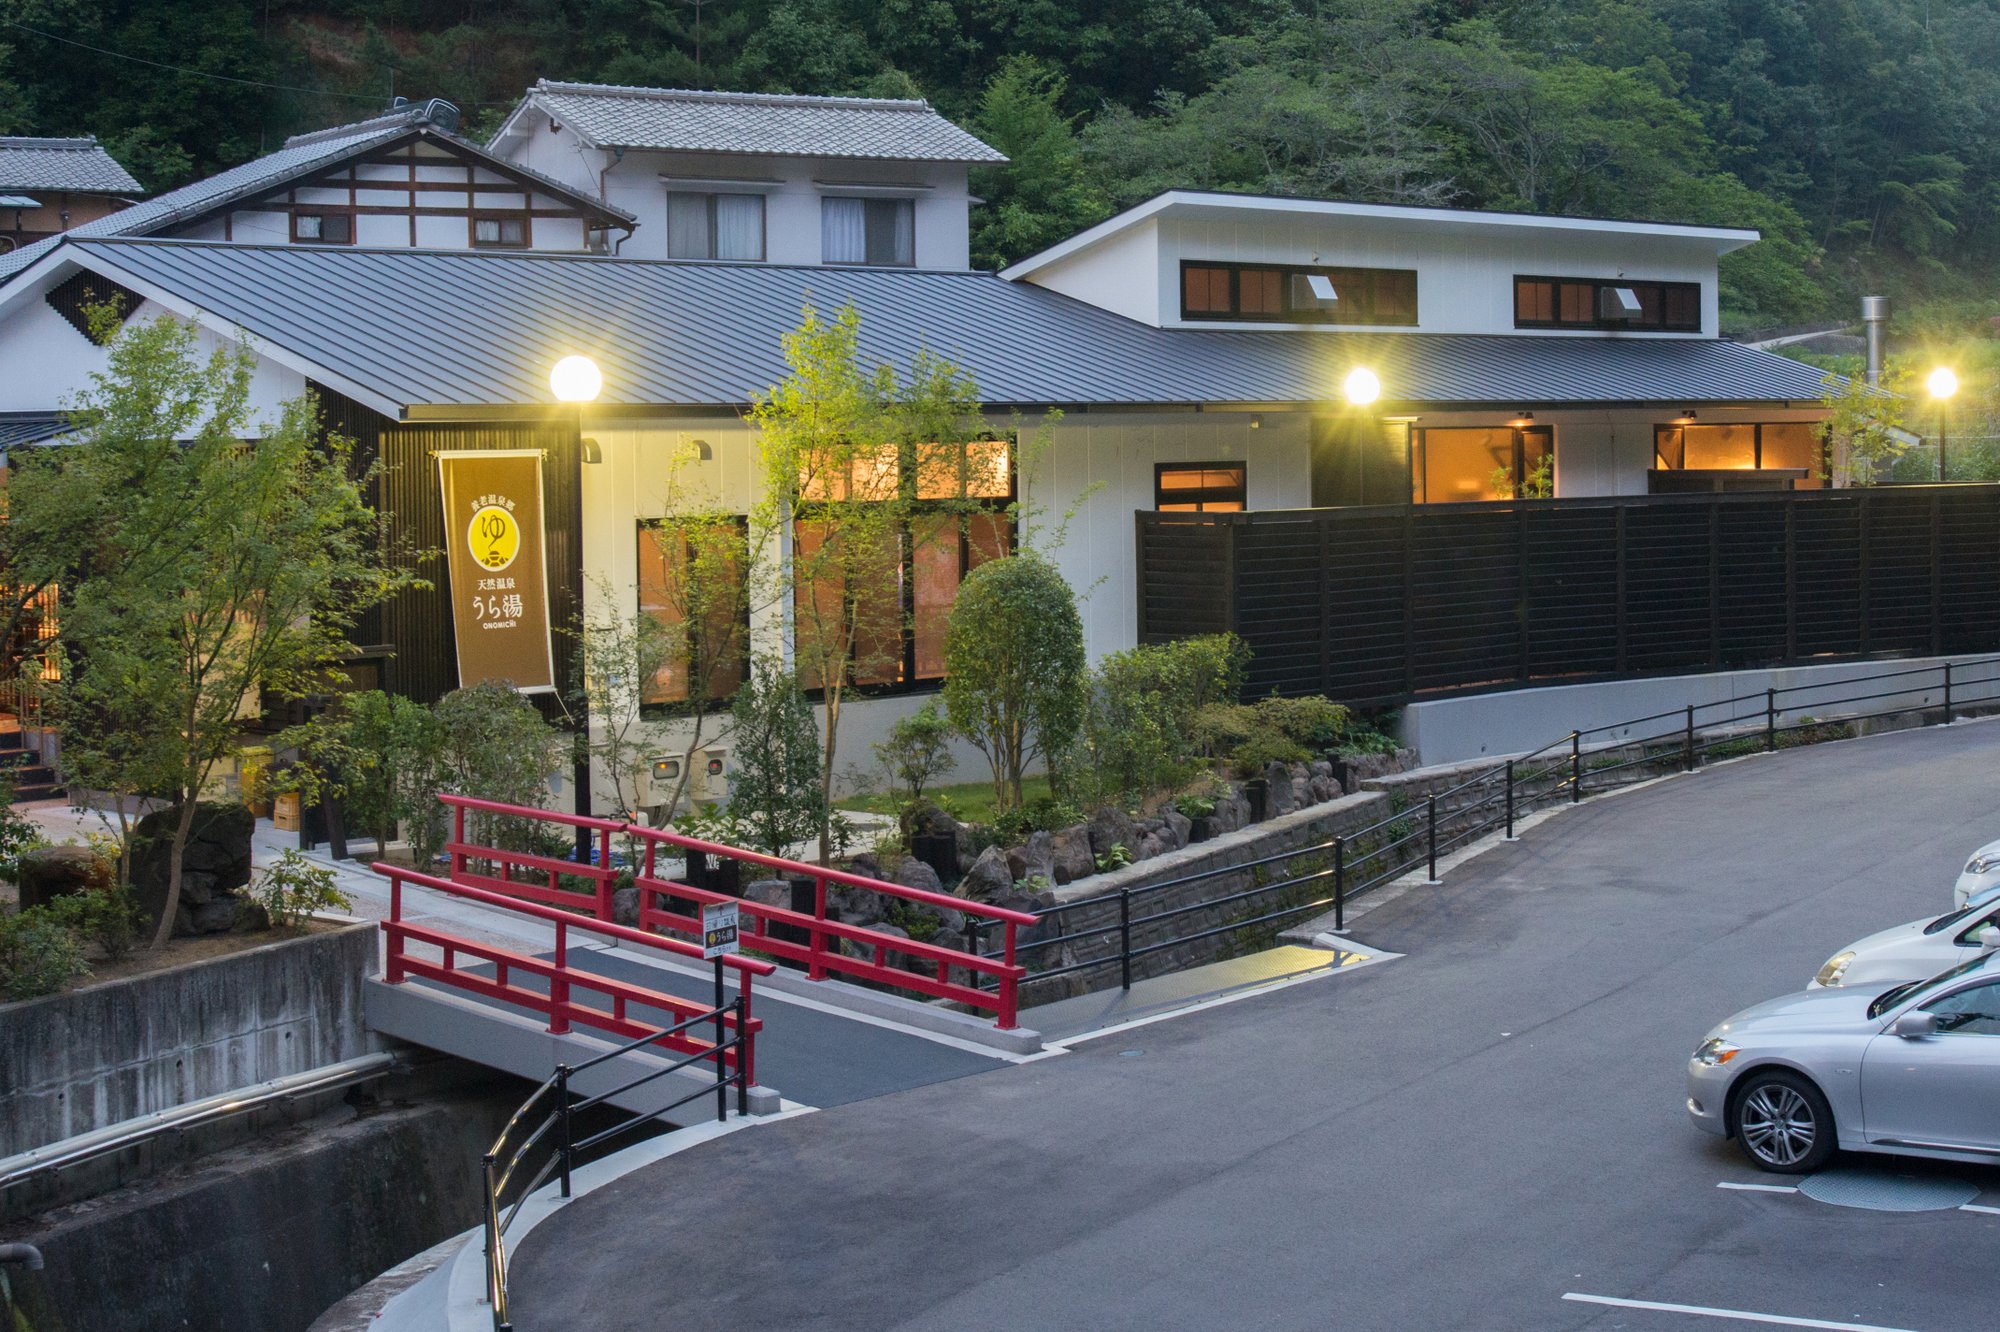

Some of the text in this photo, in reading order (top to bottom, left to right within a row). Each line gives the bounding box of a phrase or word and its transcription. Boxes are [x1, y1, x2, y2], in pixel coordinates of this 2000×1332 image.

[476, 577, 515, 590] 天然温泉
[472, 593, 523, 620] うら湯
[482, 620, 517, 630] ONOMICHI
